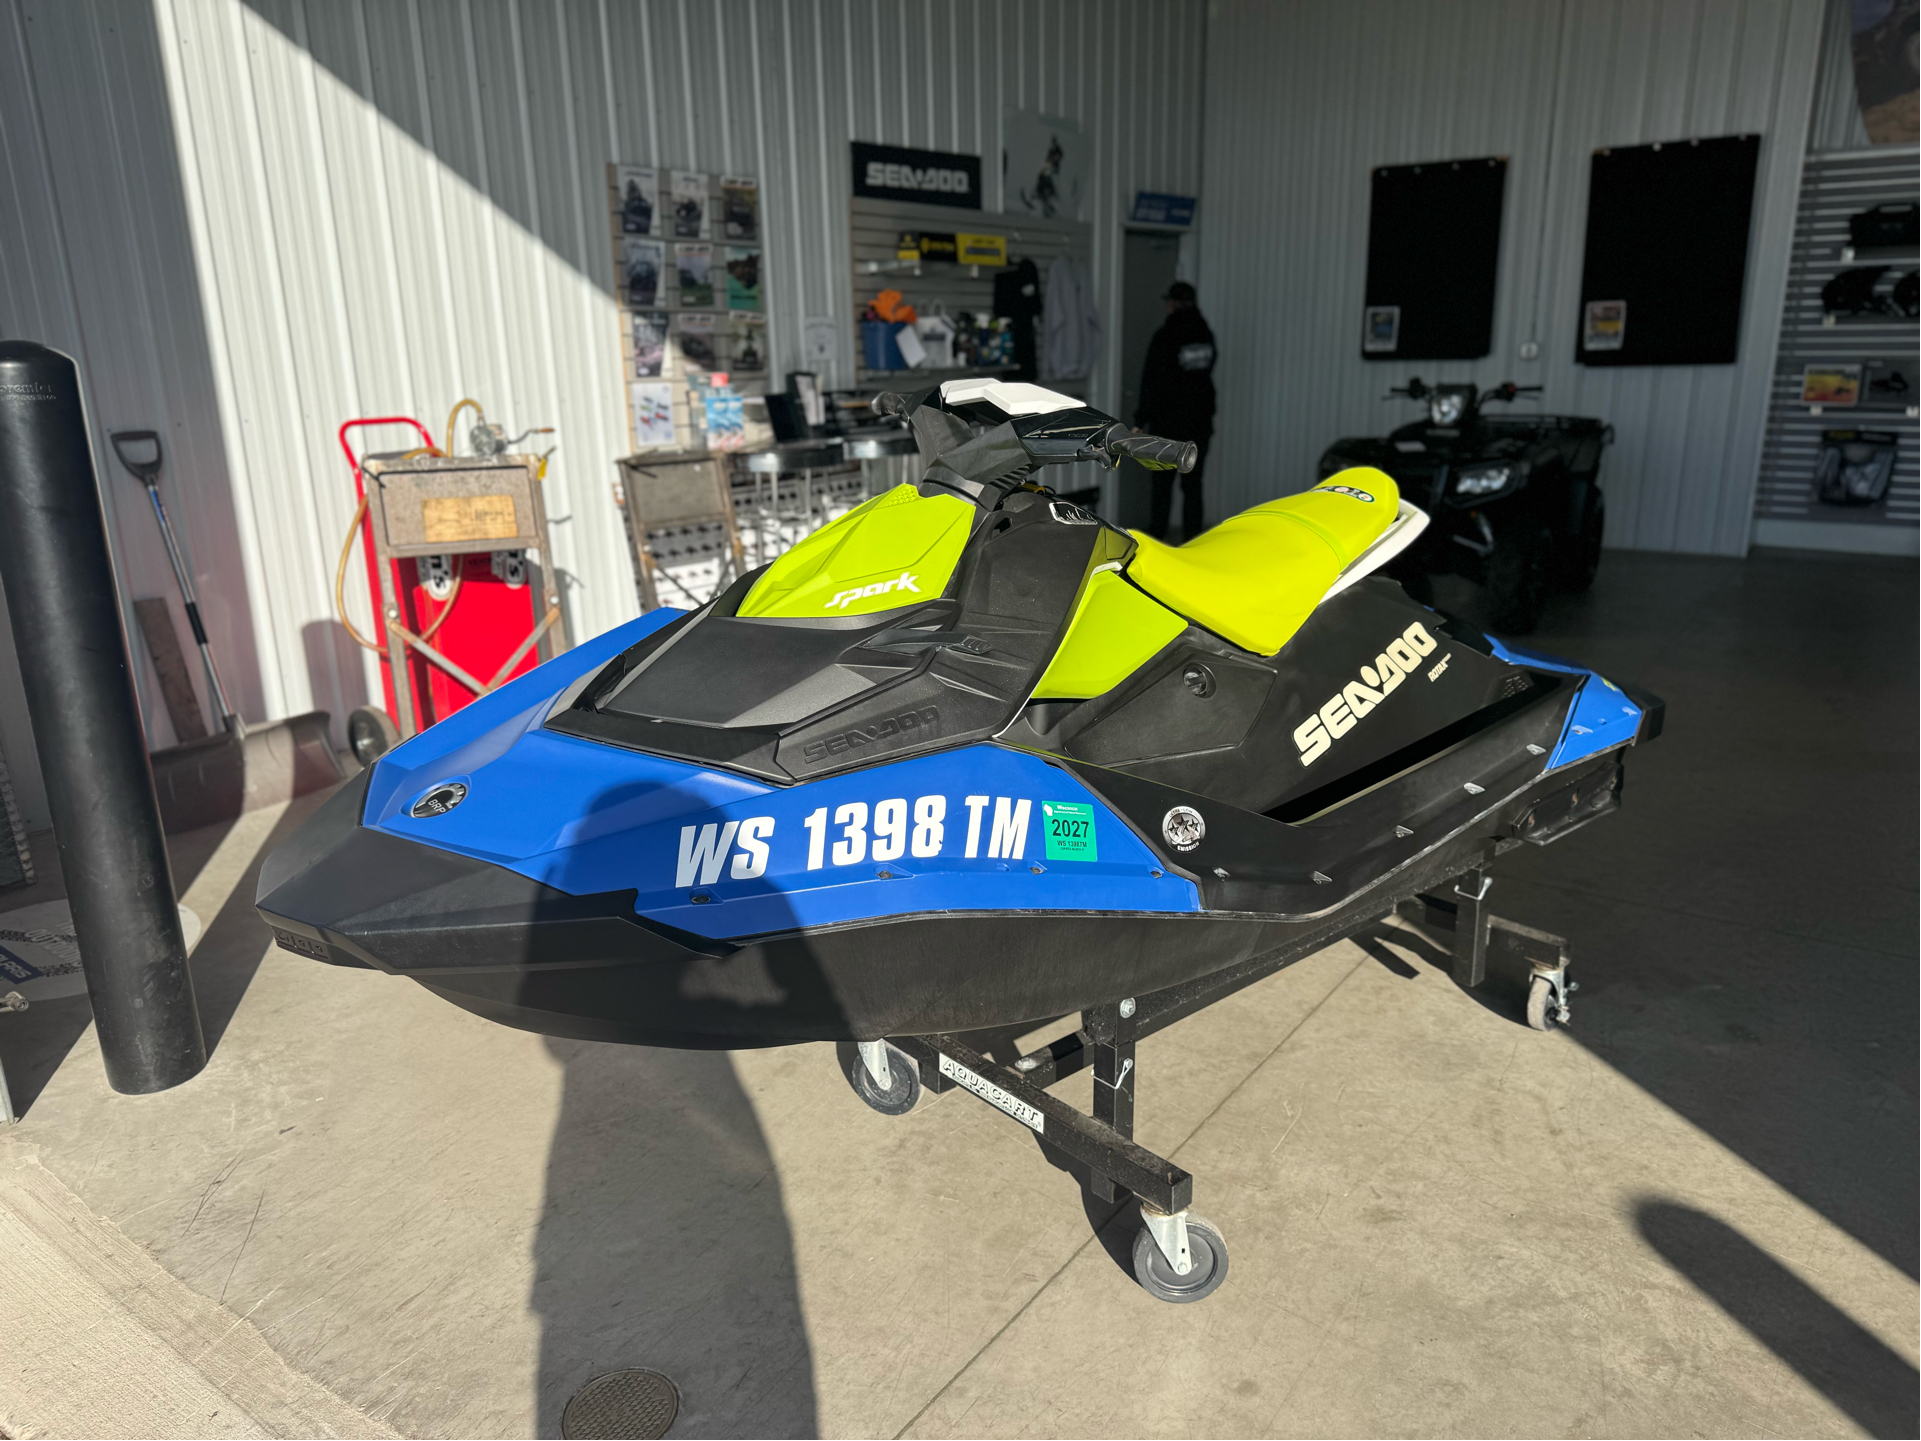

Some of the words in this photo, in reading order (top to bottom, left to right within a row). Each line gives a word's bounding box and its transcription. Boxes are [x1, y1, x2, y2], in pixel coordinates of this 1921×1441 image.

[824, 571, 922, 609] spark
[427, 798, 447, 813] BRP
[675, 816, 776, 888] WS
[804, 795, 947, 871] 1398
[964, 795, 1032, 860] TM
[1051, 818, 1090, 839] 2027
[942, 1059, 1039, 1121] AQUACART
